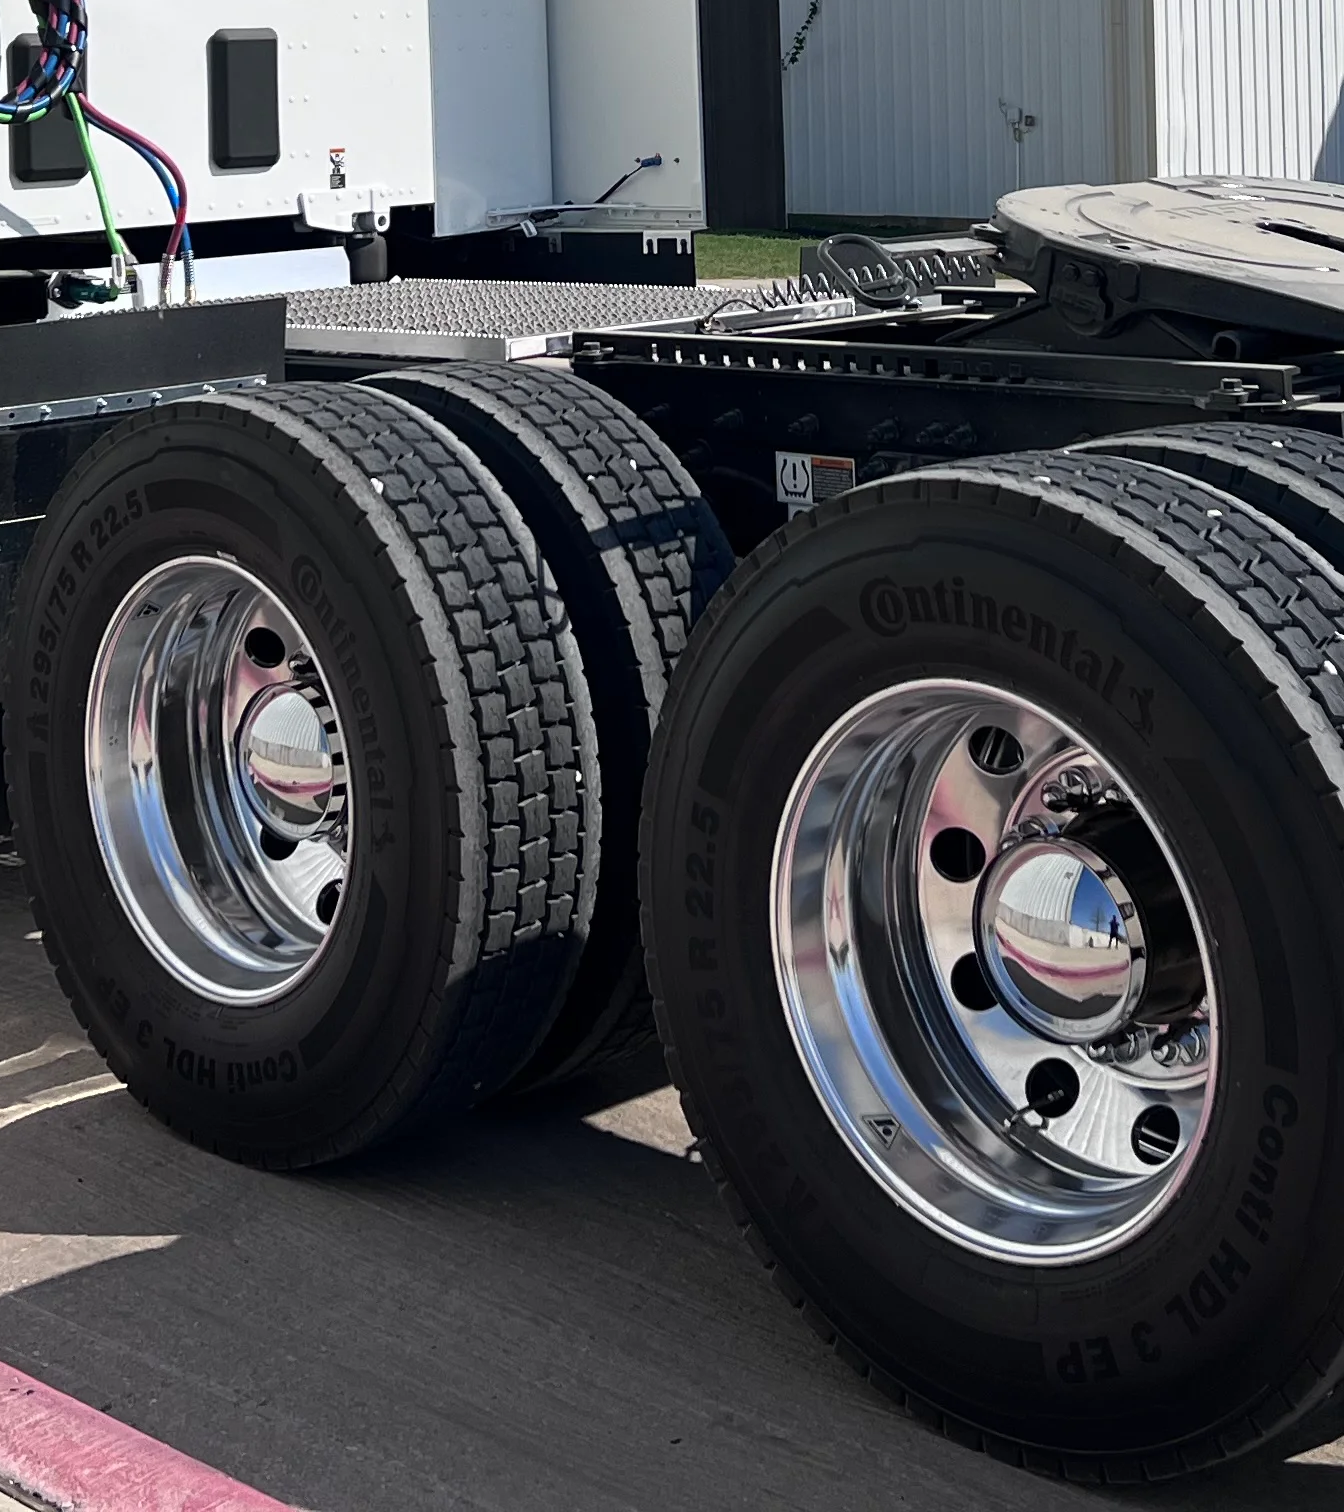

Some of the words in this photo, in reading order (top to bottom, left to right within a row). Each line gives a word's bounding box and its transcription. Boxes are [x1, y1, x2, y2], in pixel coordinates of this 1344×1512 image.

[29, 567, 76, 704] 295/75
[70, 539, 94, 573] R
[89, 488, 143, 550] 22.5
[858, 575, 1127, 702] Continental
[290, 554, 394, 811] Continental
[684, 801, 722, 920] 22.5
[687, 946, 718, 972] R
[136, 1019, 153, 1050] 3
[163, 1037, 216, 1090] HDL
[227, 1050, 298, 1094] Conti
[1234, 1083, 1299, 1246] Conti
[1164, 1238, 1252, 1337] HDL
[1055, 1335, 1121, 1384] EP
[1130, 1320, 1162, 1363] 3
